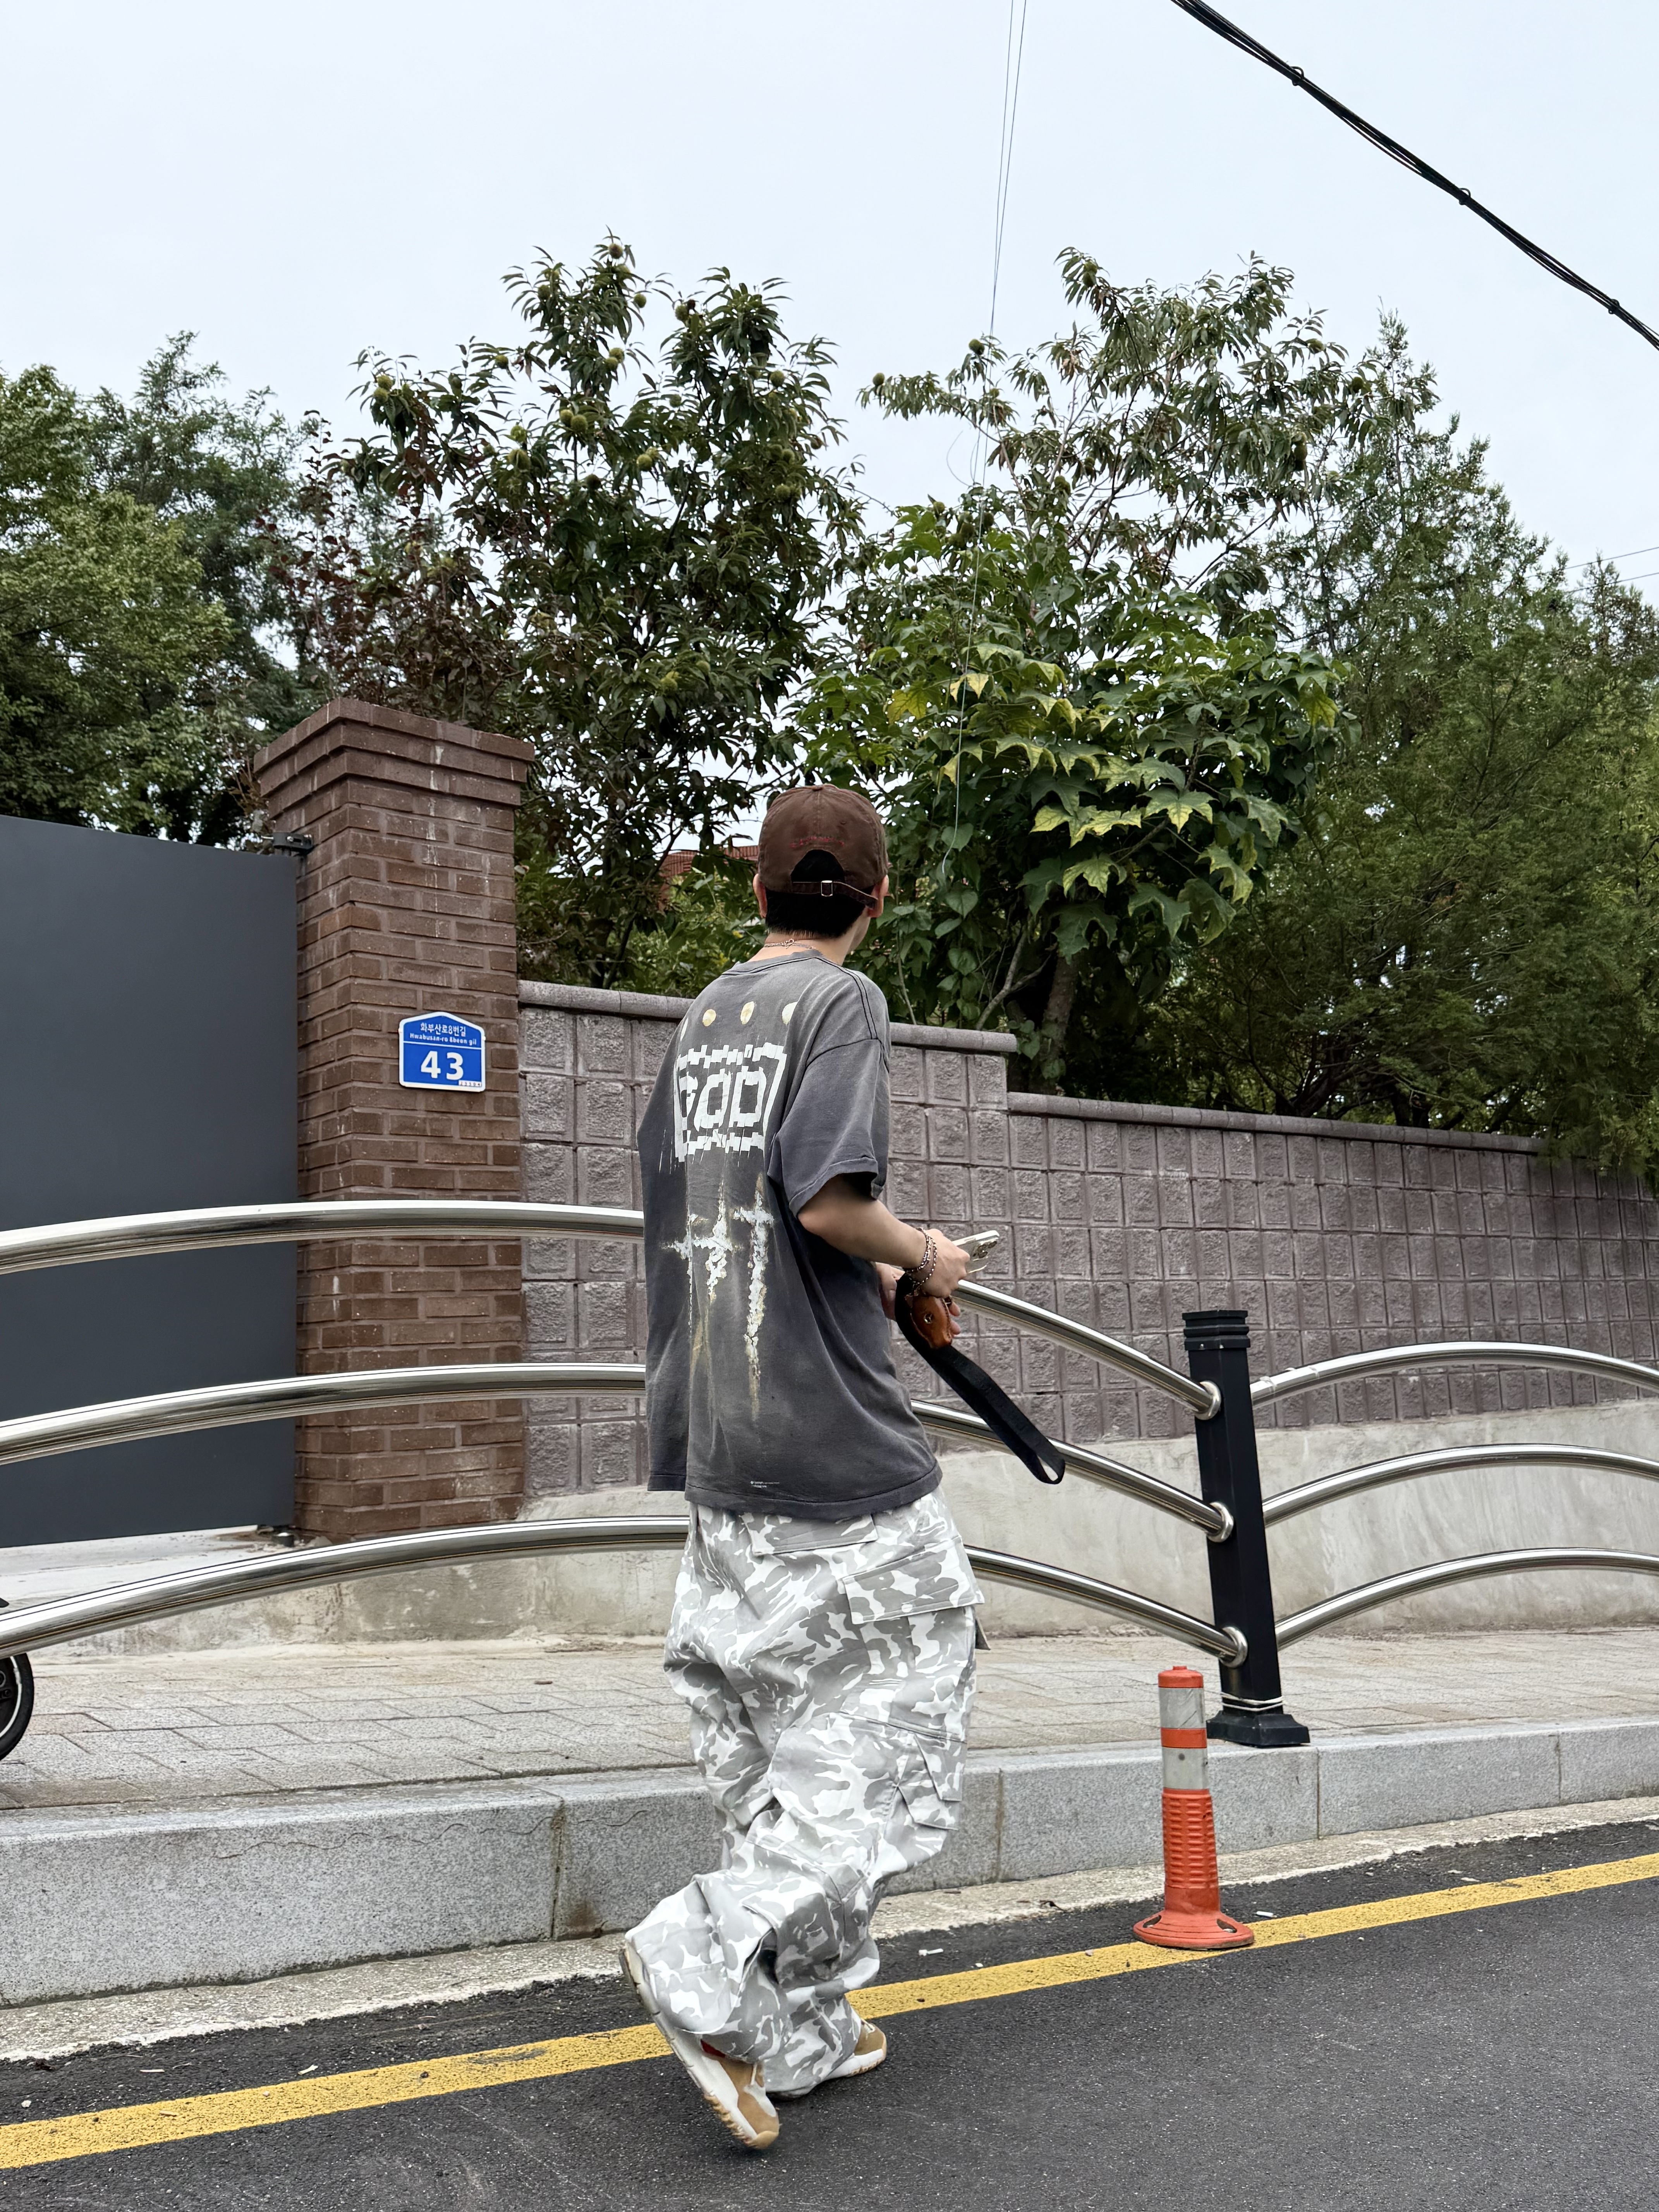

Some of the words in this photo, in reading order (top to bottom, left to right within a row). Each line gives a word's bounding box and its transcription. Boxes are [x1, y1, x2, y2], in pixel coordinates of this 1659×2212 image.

[421, 1022, 466, 1037] 화부산로8번길
[410, 1033, 448, 1042] Hwabusan-ro
[421, 1051, 464, 1080] 43
